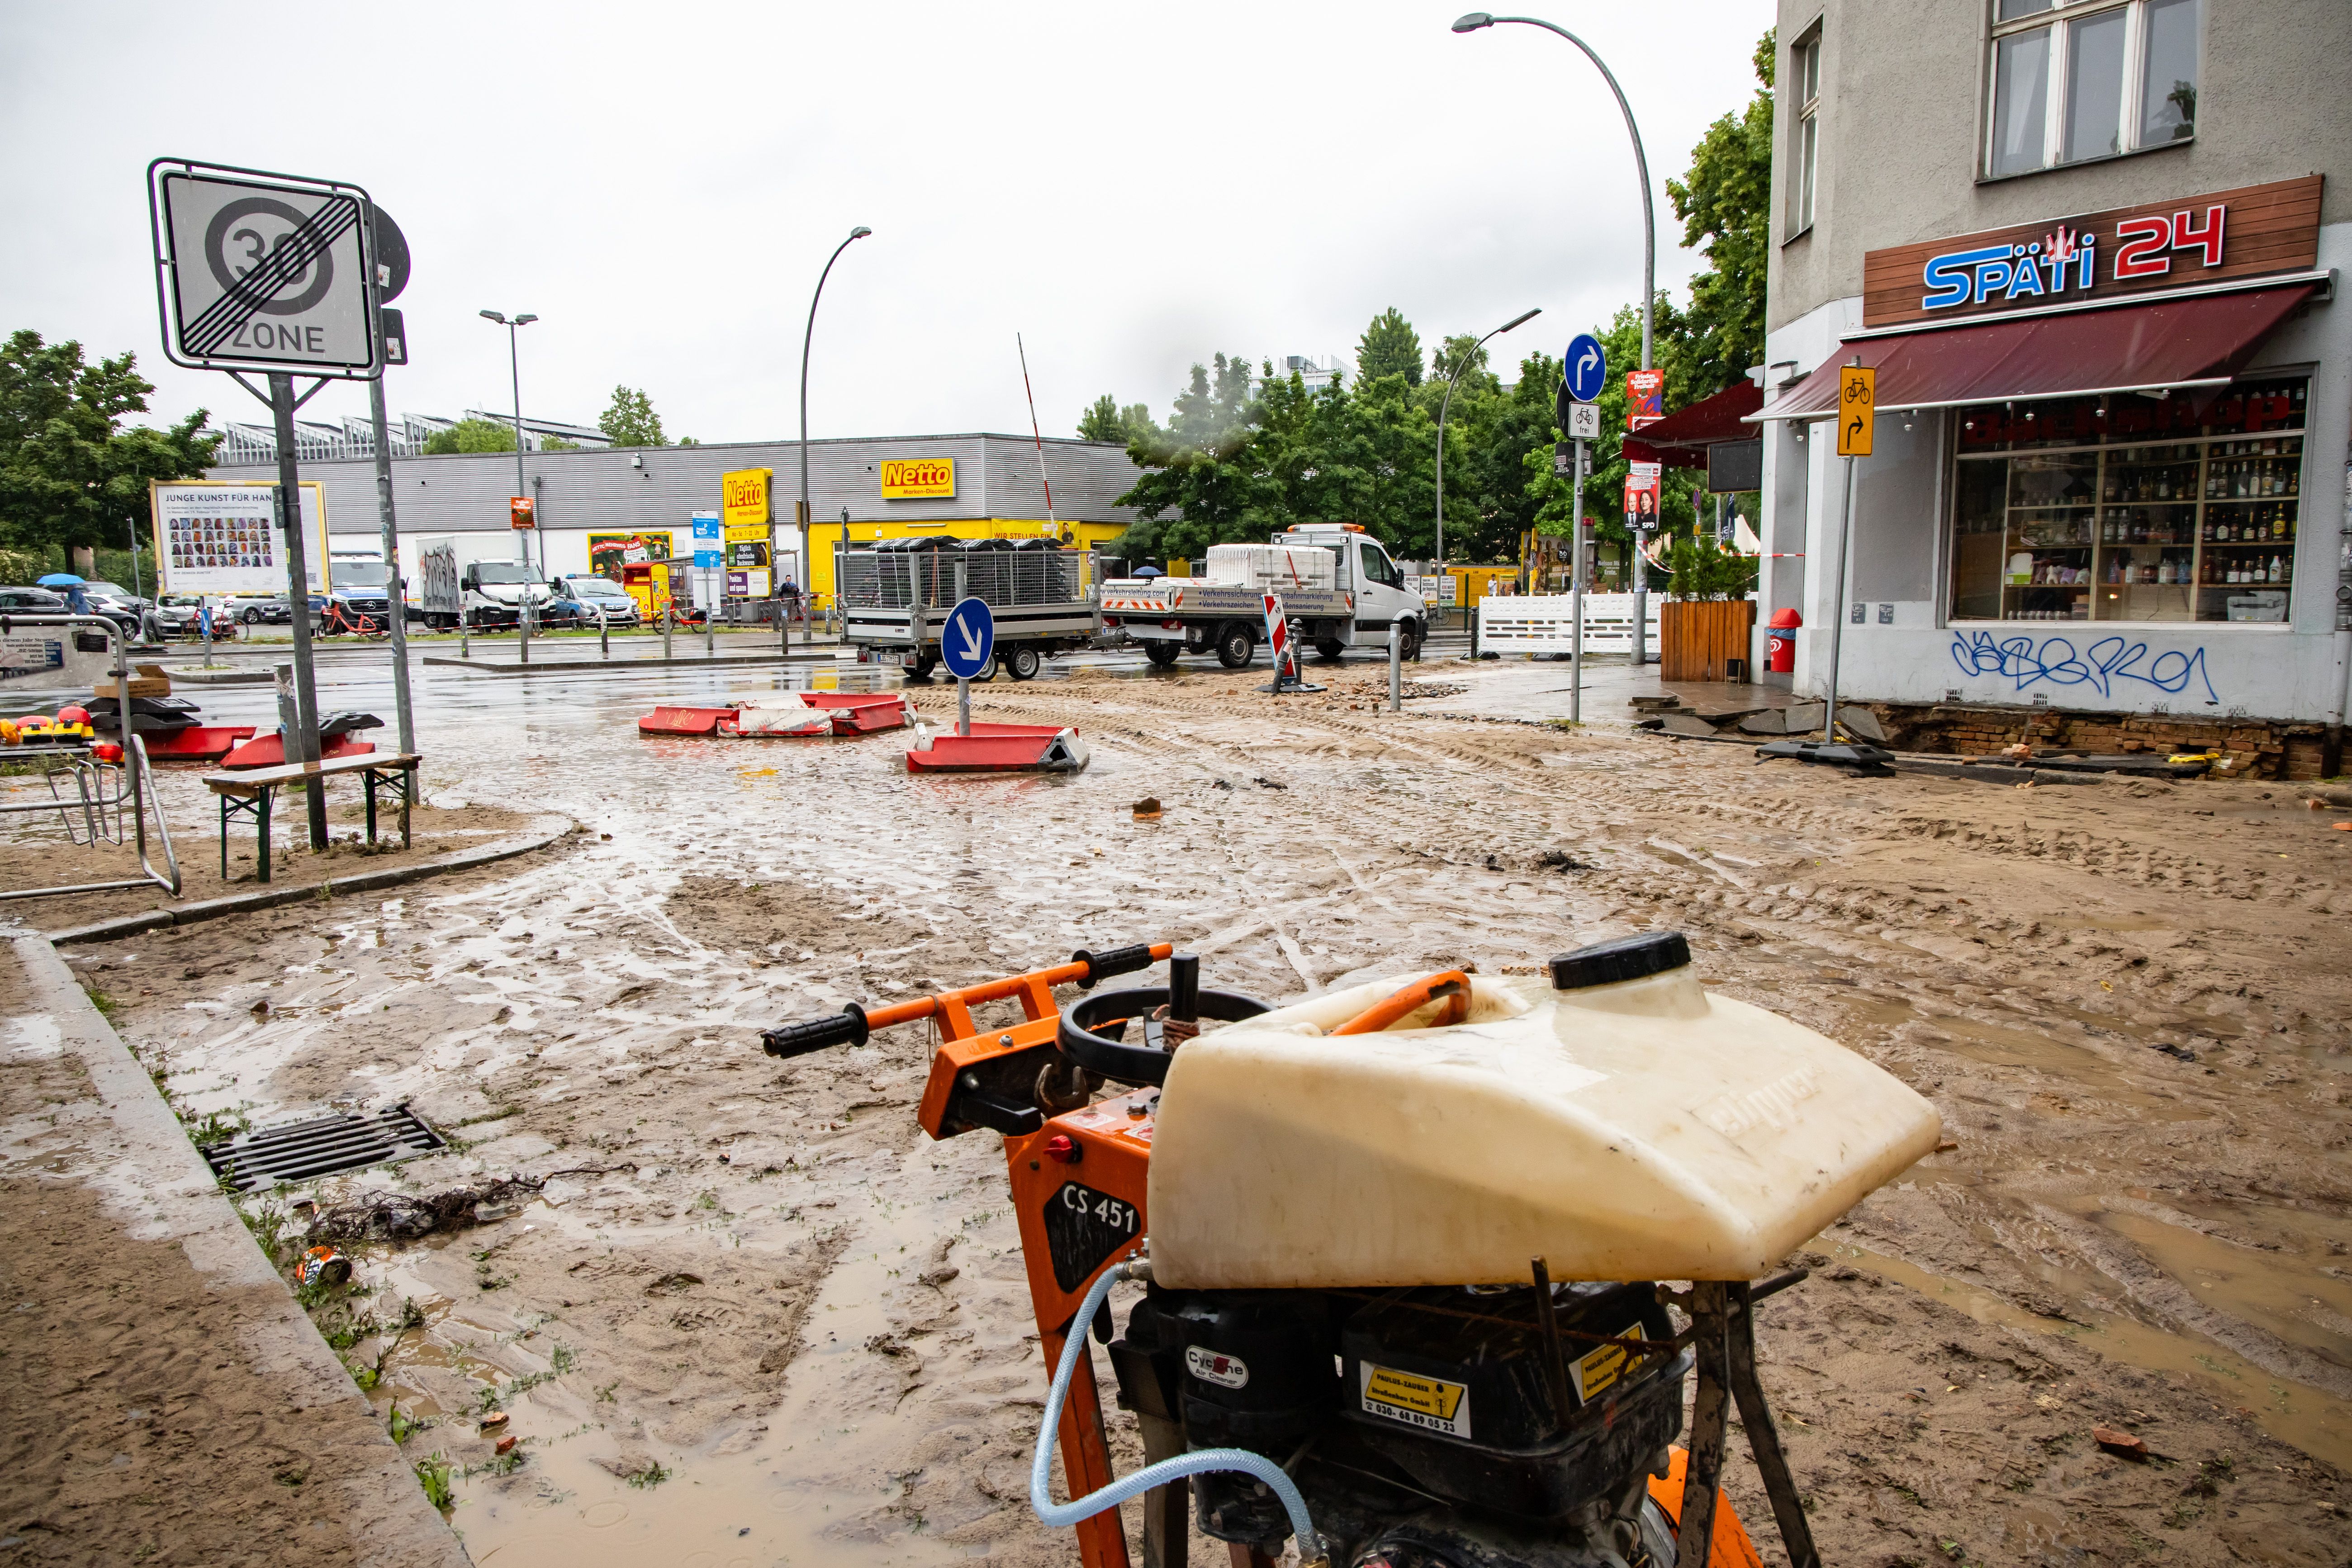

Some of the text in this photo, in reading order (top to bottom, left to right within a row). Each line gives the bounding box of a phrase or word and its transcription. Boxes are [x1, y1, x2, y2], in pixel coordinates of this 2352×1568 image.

[2114, 204, 2226, 279] 24
[232, 228, 307, 285] 30
[232, 320, 326, 353] ZONE
[1579, 426, 1589, 434] frei
[885, 464, 950, 486] Netto
[232, 493, 249, 502] FÜR
[727, 480, 763, 507] Netto
[627, 541, 640, 550] FANS
[736, 585, 747, 593] sparen
[1203, 590, 1333, 602] Verkehrssicherung hrbahnmarkierung
[1203, 600, 1324, 611] Verkehrszeichen aßensanierung
[1063, 1184, 1134, 1233] CS 451
[1189, 1351, 1243, 1375] Cyclone
[1585, 1345, 1624, 1374] PAULUS-ZAUBER
[1195, 1368, 1238, 1385] Air Cleaner
[1376, 1374, 1430, 1393] PAULUS-ZAUBER
[1371, 1387, 1430, 1407] Straßenbau GmbH
[1376, 1404, 1455, 1432] 030- 68 89 05 23
